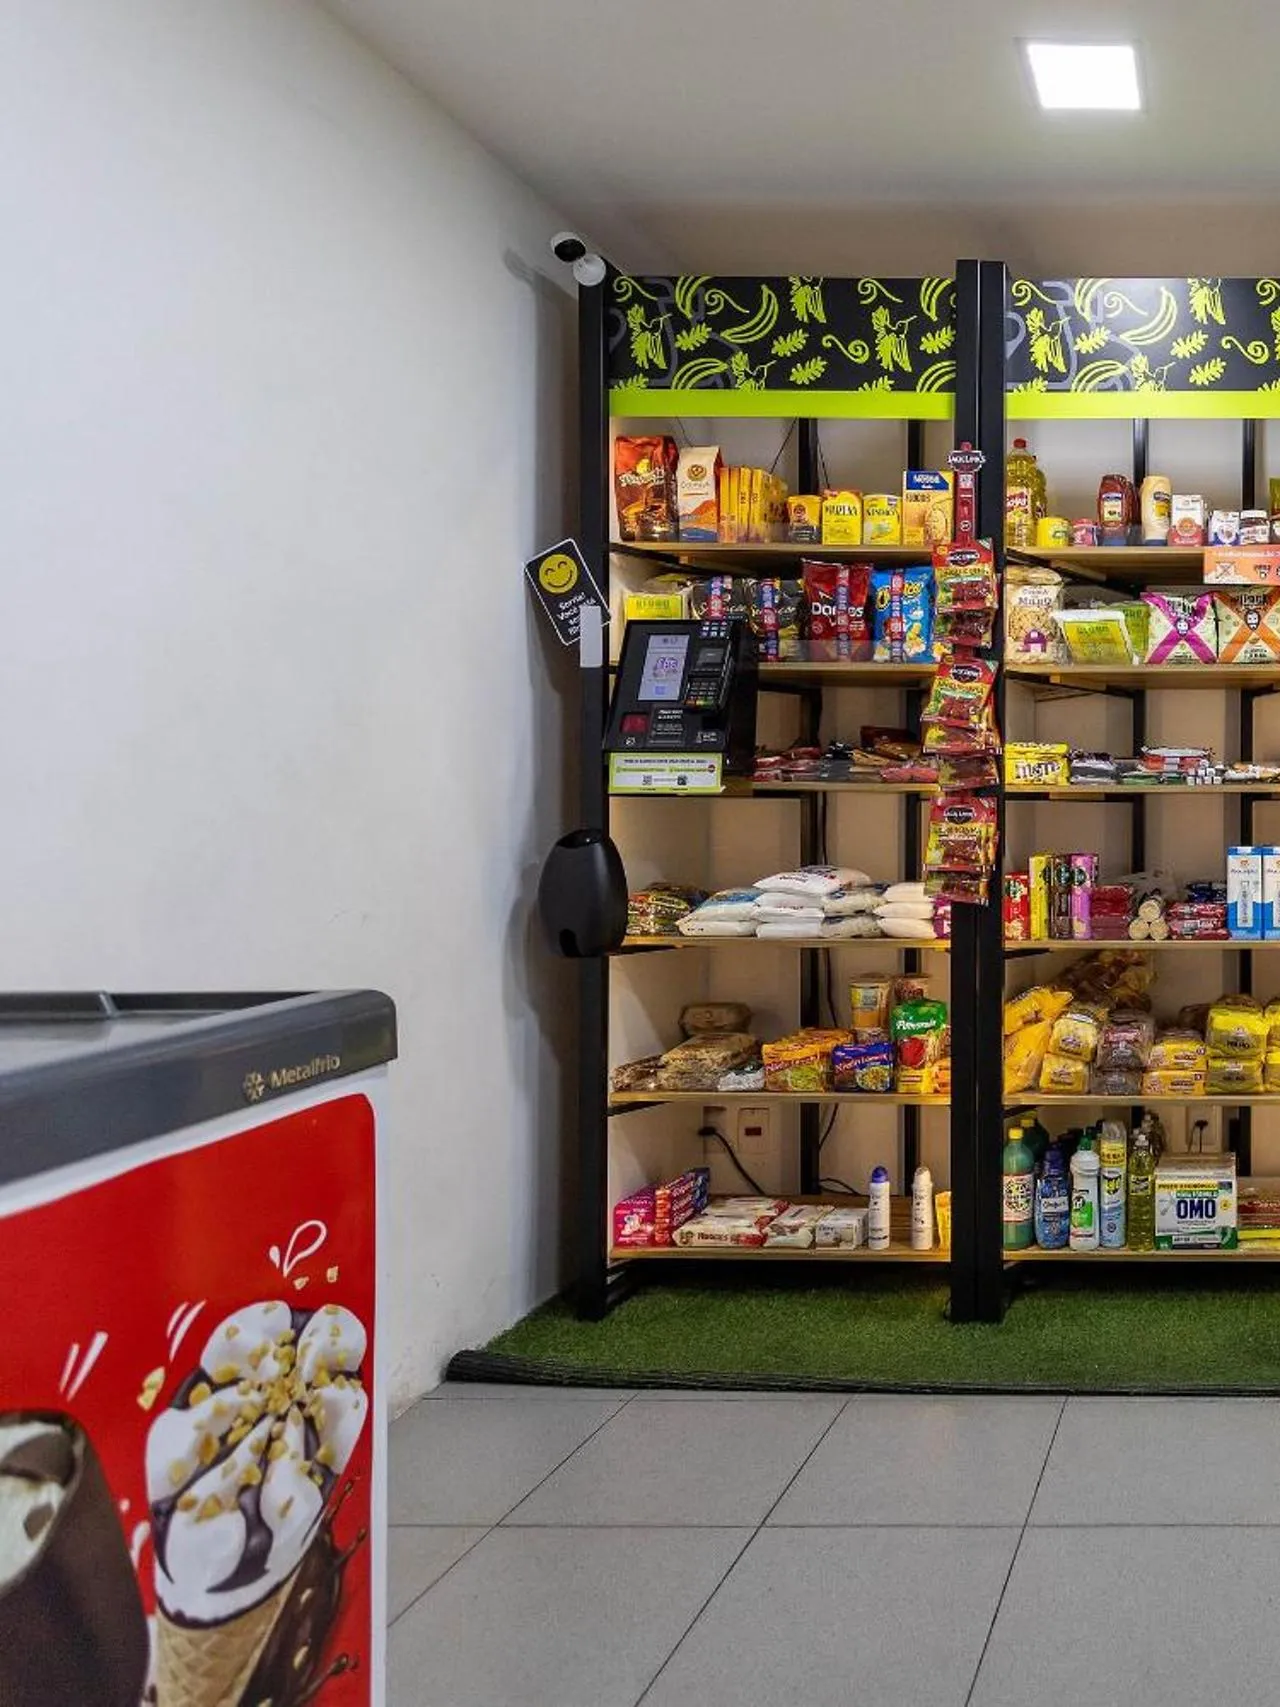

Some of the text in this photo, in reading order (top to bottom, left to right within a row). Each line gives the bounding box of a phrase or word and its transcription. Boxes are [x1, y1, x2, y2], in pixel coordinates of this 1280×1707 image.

[811, 602, 864, 618] Doros
[270, 1055, 341, 1087] Metalfrio
[1176, 1199, 1217, 1219] OMO
